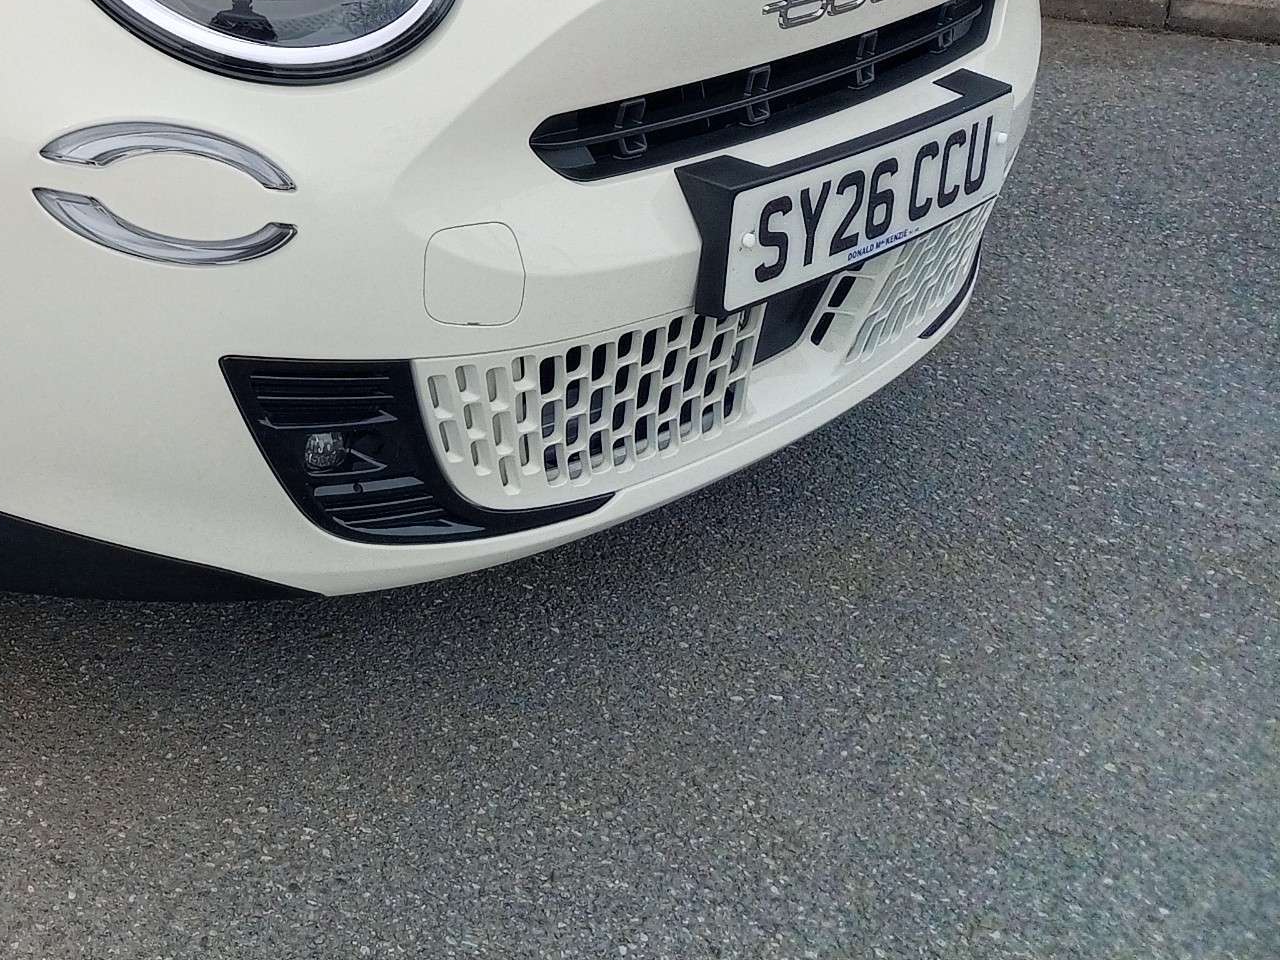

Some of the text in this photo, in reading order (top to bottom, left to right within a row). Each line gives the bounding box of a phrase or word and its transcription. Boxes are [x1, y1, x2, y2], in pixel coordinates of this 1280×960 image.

[754, 115, 994, 283] SY26 CCU
[847, 243, 875, 262] DONALD
